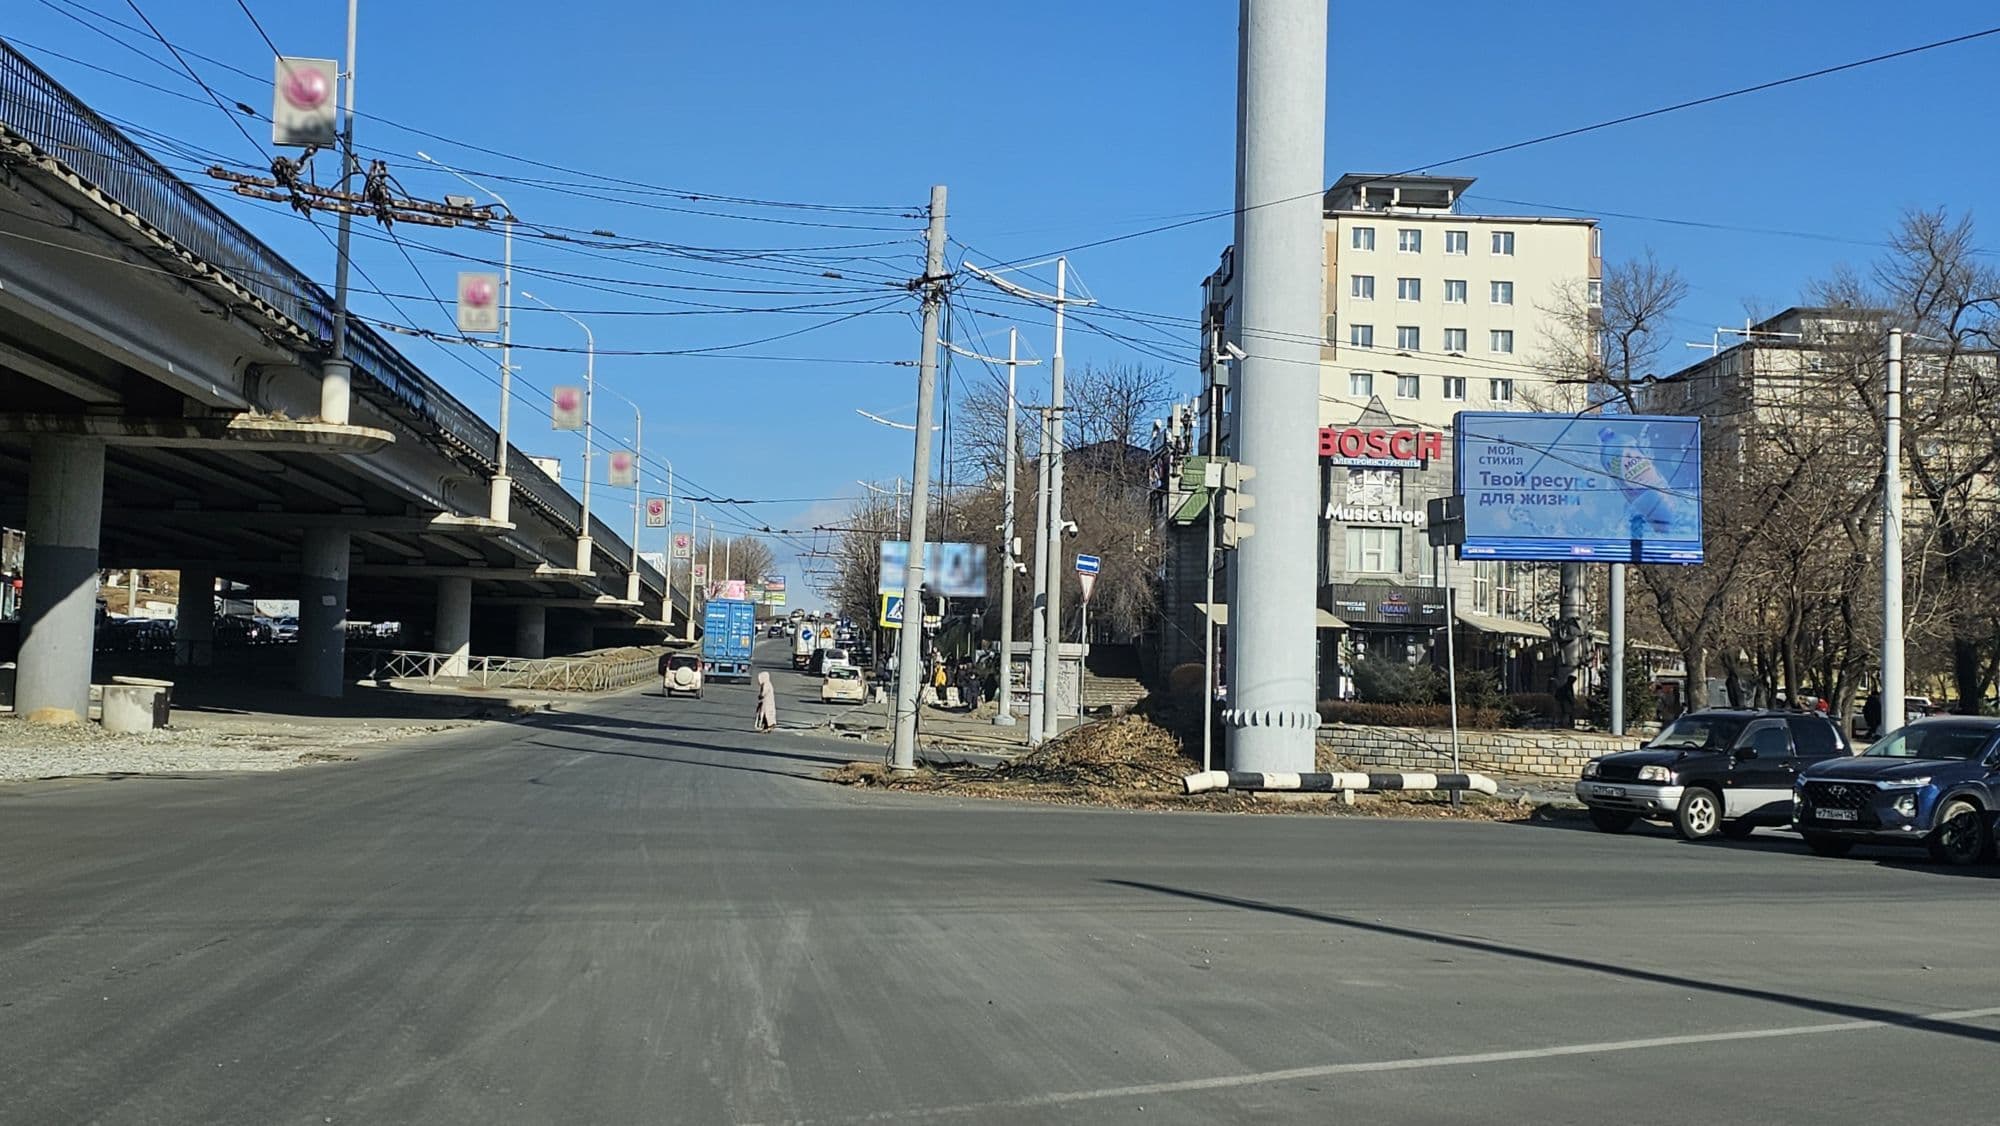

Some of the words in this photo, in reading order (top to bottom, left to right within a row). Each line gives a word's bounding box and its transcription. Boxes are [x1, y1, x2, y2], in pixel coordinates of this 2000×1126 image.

[1319, 427, 1442, 460] BOSCH
[1487, 446, 1514, 455] МОЯ
[1479, 456, 1523, 466] СТИХИЯ
[1479, 471, 1525, 487] Твой
[1479, 493, 1515, 506] для
[1520, 493, 1581, 506] жизни
[1325, 502, 1375, 522] Music
[1382, 504, 1426, 526] shop
[649, 517, 661, 525] LG
